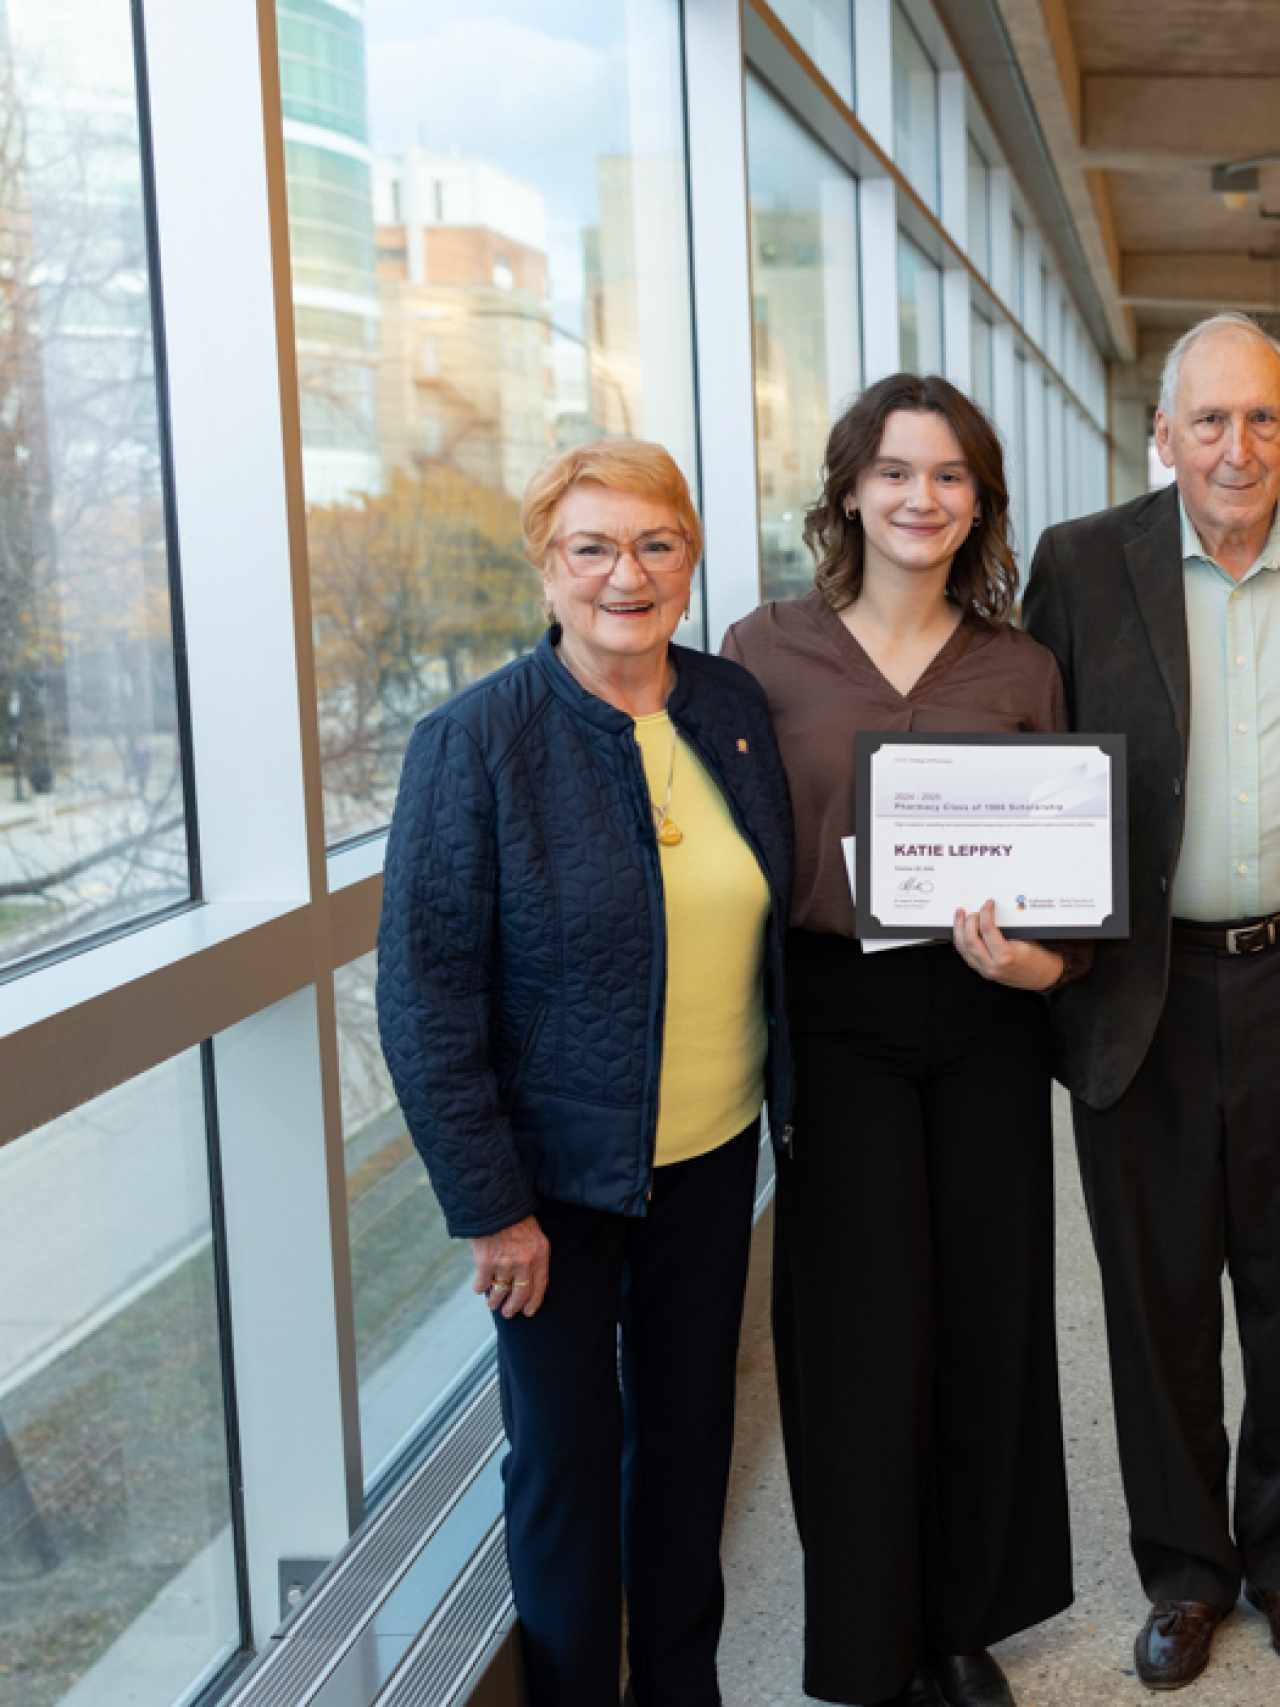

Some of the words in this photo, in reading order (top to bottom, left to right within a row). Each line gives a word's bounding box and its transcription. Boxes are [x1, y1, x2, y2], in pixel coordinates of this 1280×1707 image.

[894, 802, 940, 813] Pharmacy
[943, 802, 969, 811] Class
[1008, 802, 1064, 813] Scholarship
[894, 843, 944, 857] KATIE
[948, 843, 1013, 857] LEPPKY
